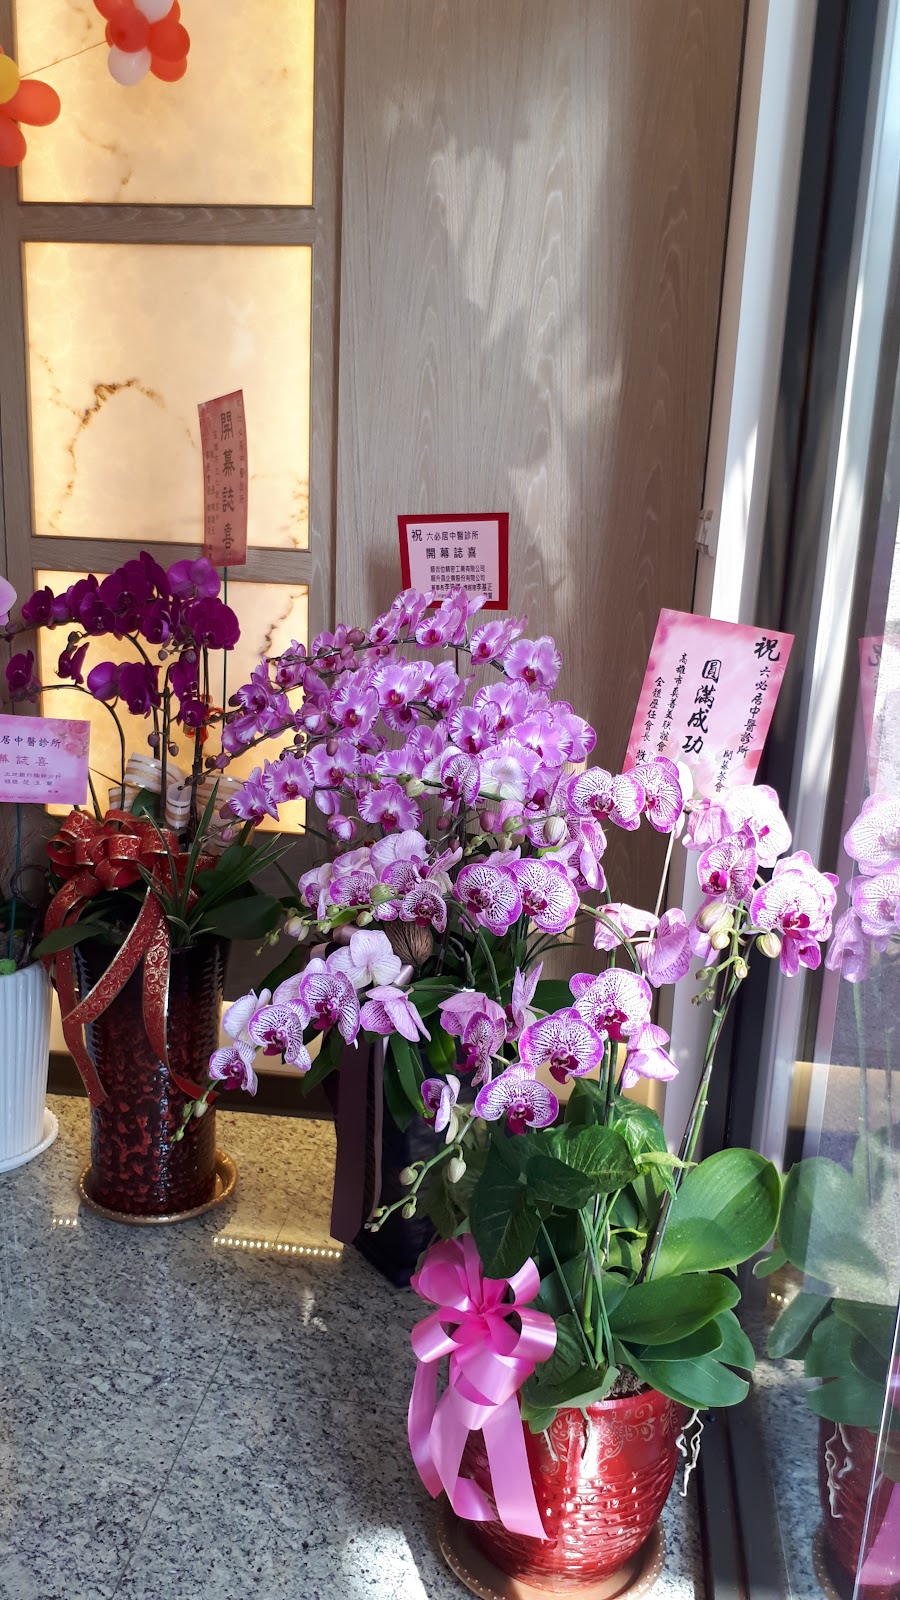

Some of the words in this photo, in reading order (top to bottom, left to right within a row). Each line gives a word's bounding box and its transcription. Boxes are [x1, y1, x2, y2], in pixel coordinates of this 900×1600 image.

[220, 410, 236, 549] 開幕誌喜
[411, 529, 423, 542] 祝
[426, 530, 479, 541] 六必居中醫診所
[425, 546, 477, 559] 開幕誌喜
[753, 636, 781, 662] 祝
[681, 659, 722, 755] 圓滿成功
[736, 665, 772, 759] 六必居中醫診所
[714, 749, 734, 793] 開幕茶會
